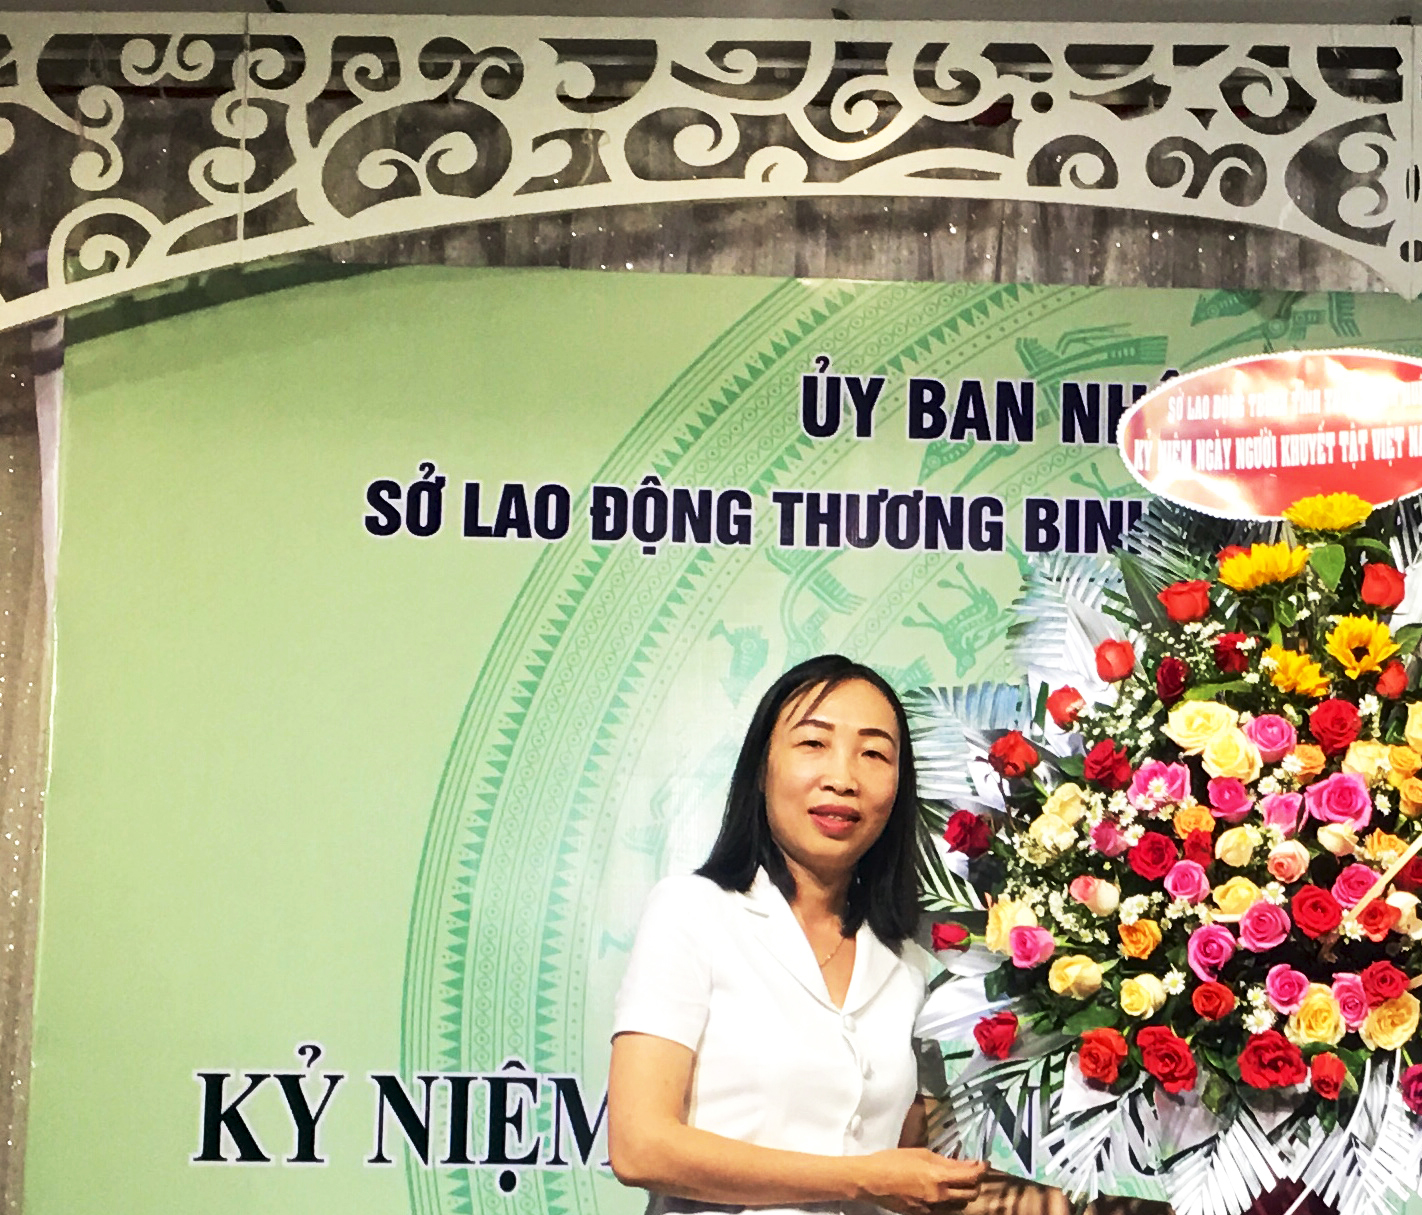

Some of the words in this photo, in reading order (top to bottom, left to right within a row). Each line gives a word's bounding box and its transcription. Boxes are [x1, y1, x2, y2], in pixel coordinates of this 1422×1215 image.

[803, 356, 885, 438] ỦY
[908, 378, 1034, 442] BAN
[1196, 429, 1232, 471] NGÀY
[1235, 427, 1277, 470] NGƯỜI
[1281, 420, 1336, 467] KHUYẾT
[1339, 421, 1369, 470] TẬT
[1371, 420, 1405, 467] VIỆT
[366, 461, 445, 537] SỞ
[463, 482, 571, 540] LAO
[590, 476, 752, 555] ĐỘNG
[773, 488, 1004, 552] THƯƠNG
[193, 1045, 344, 1163] KỶ
[367, 1060, 611, 1193] NIỆM
